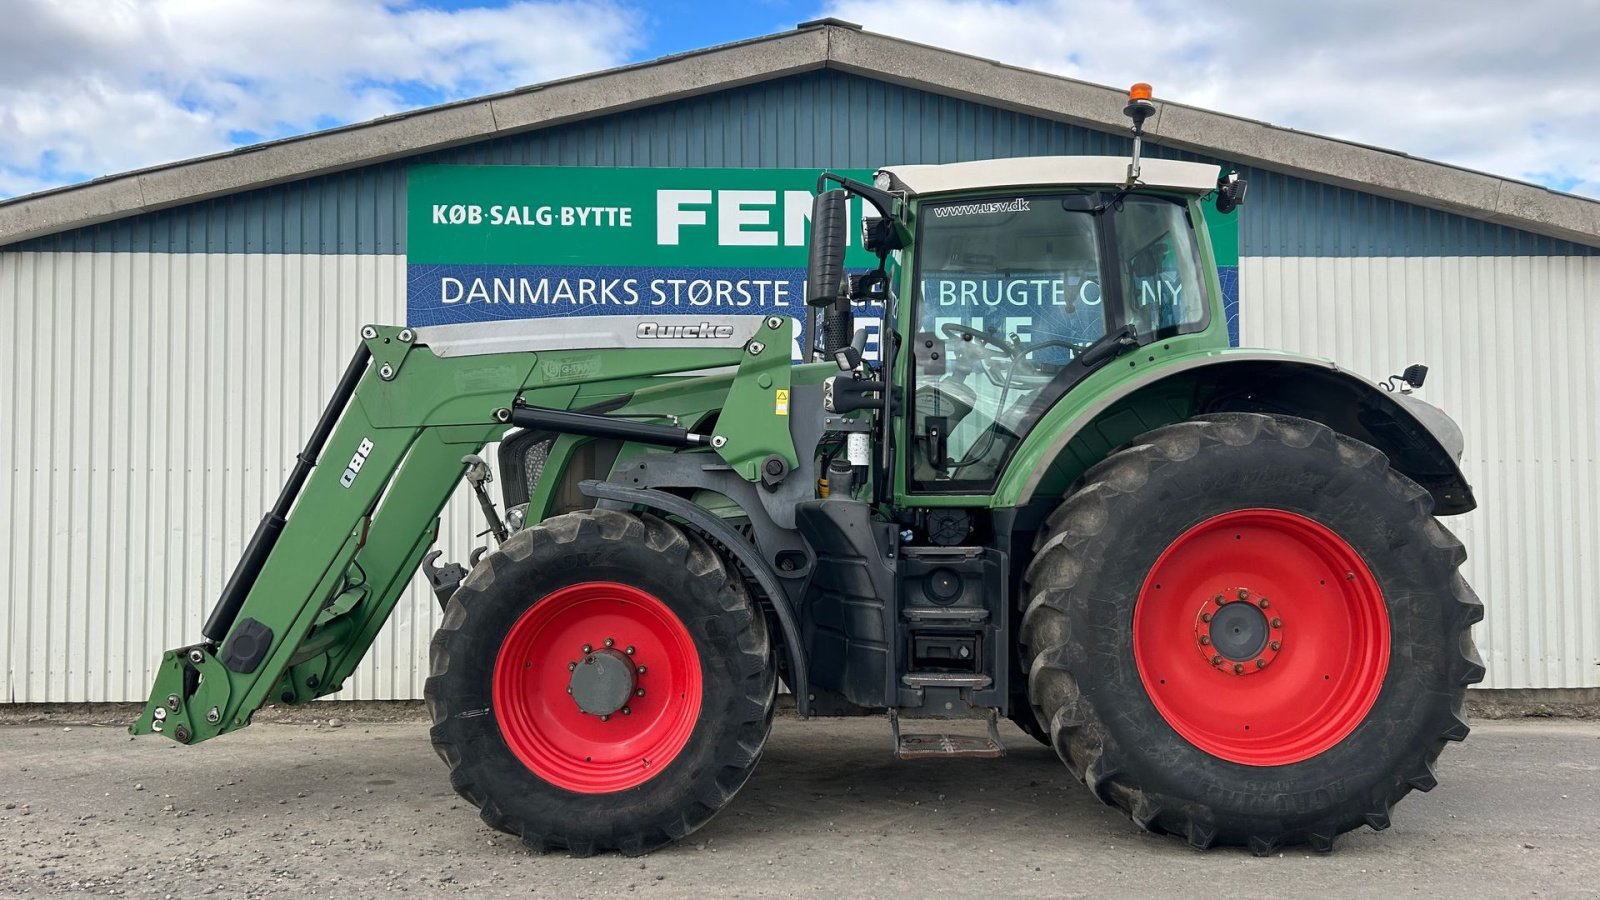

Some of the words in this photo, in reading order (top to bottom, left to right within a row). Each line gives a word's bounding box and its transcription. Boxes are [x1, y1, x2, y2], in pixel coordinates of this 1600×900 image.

[934, 198, 1030, 217] www.usv.dk
[441, 277, 638, 305] DANMARKS
[651, 279, 789, 306] STØRSTE
[939, 280, 1067, 306] BRUGTE
[636, 321, 734, 339] Quicke
